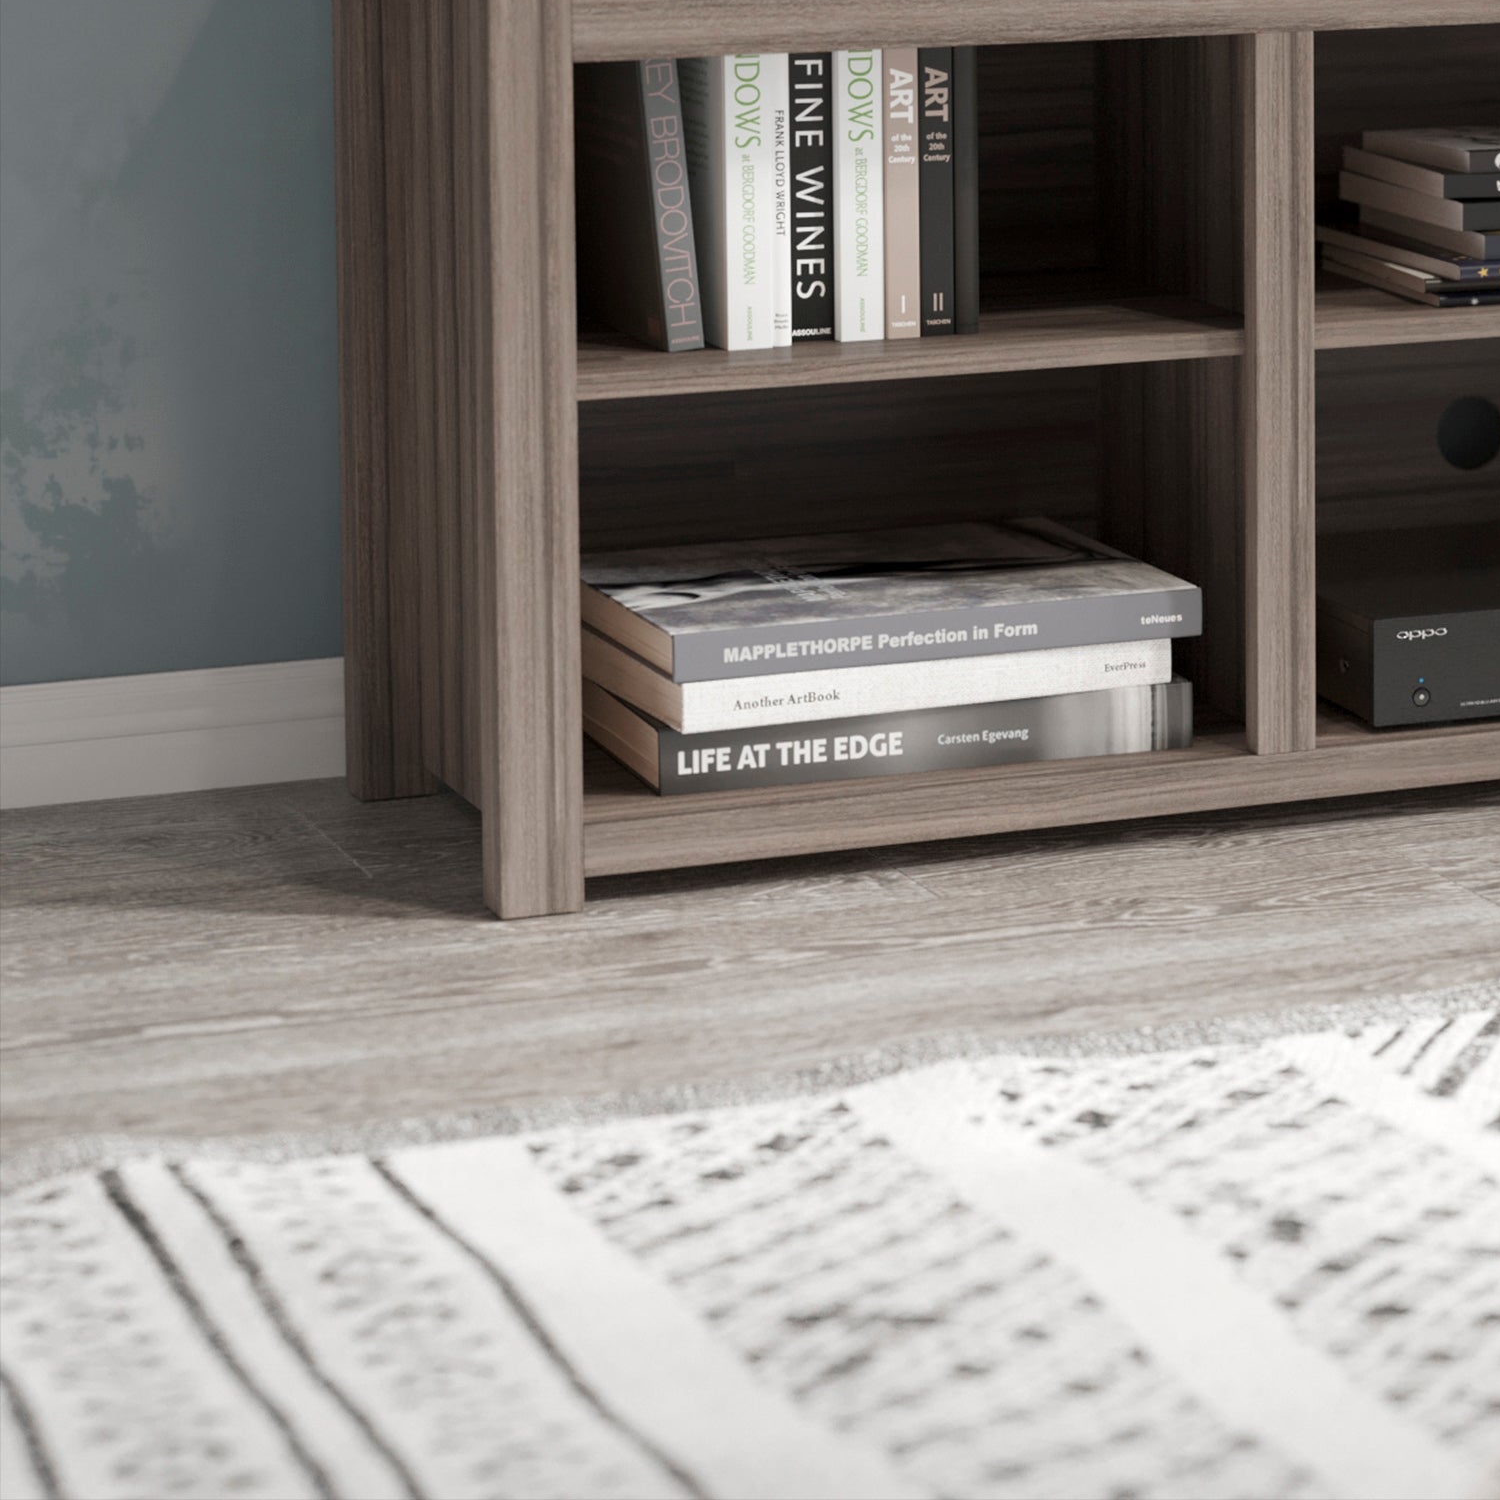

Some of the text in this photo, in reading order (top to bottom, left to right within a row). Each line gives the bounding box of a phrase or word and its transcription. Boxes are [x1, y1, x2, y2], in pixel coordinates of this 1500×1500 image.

[847, 49, 874, 142] DOWS
[889, 68, 914, 124] ART
[924, 66, 949, 122] ART
[891, 133, 912, 142] of the
[894, 144, 910, 153] 20th
[926, 131, 947, 140] of the
[928, 143, 945, 151] 20th
[775, 110, 786, 236] FRANK LLOYD WRIGHT
[888, 155, 915, 164] Century
[923, 154, 951, 163] Century
[742, 165, 755, 222] BERGDORF
[794, 59, 826, 299] FINE WINES
[855, 158, 867, 215] BERGDORF
[650, 115, 697, 327] BRODOVITCH
[743, 225, 756, 285] GOODMAN
[856, 218, 868, 277] GOODMAN
[792, 327, 832, 336] ASSOULINE
[1140, 613, 1183, 625] teNeues
[1396, 627, 1448, 641] oppo
[723, 622, 1038, 663] MAPPLETHORPE Perfection in Form
[1104, 660, 1146, 673] EverPress
[733, 689, 841, 711] Another ArtBook
[937, 728, 1029, 746] Carsten Egevang
[677, 731, 903, 775] LIFE AT THE EDGE
